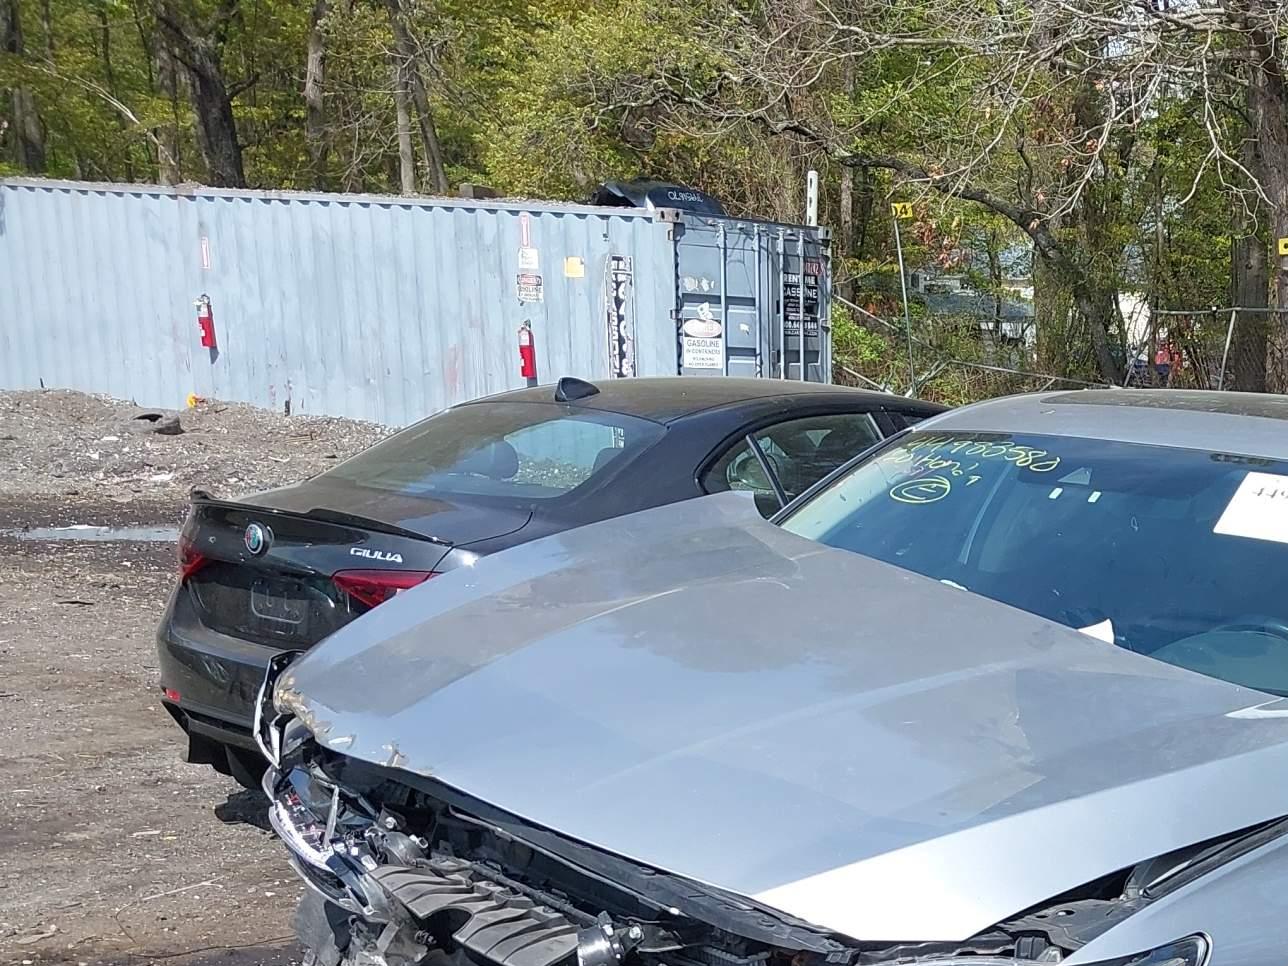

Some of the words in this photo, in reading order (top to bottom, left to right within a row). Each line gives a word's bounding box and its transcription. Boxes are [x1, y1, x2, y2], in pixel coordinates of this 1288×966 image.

[783, 287, 818, 298] ASSNE
[687, 339, 719, 348] GASOLINE
[907, 436, 1061, 472] 44983580
[350, 547, 403, 563] GIULIA
